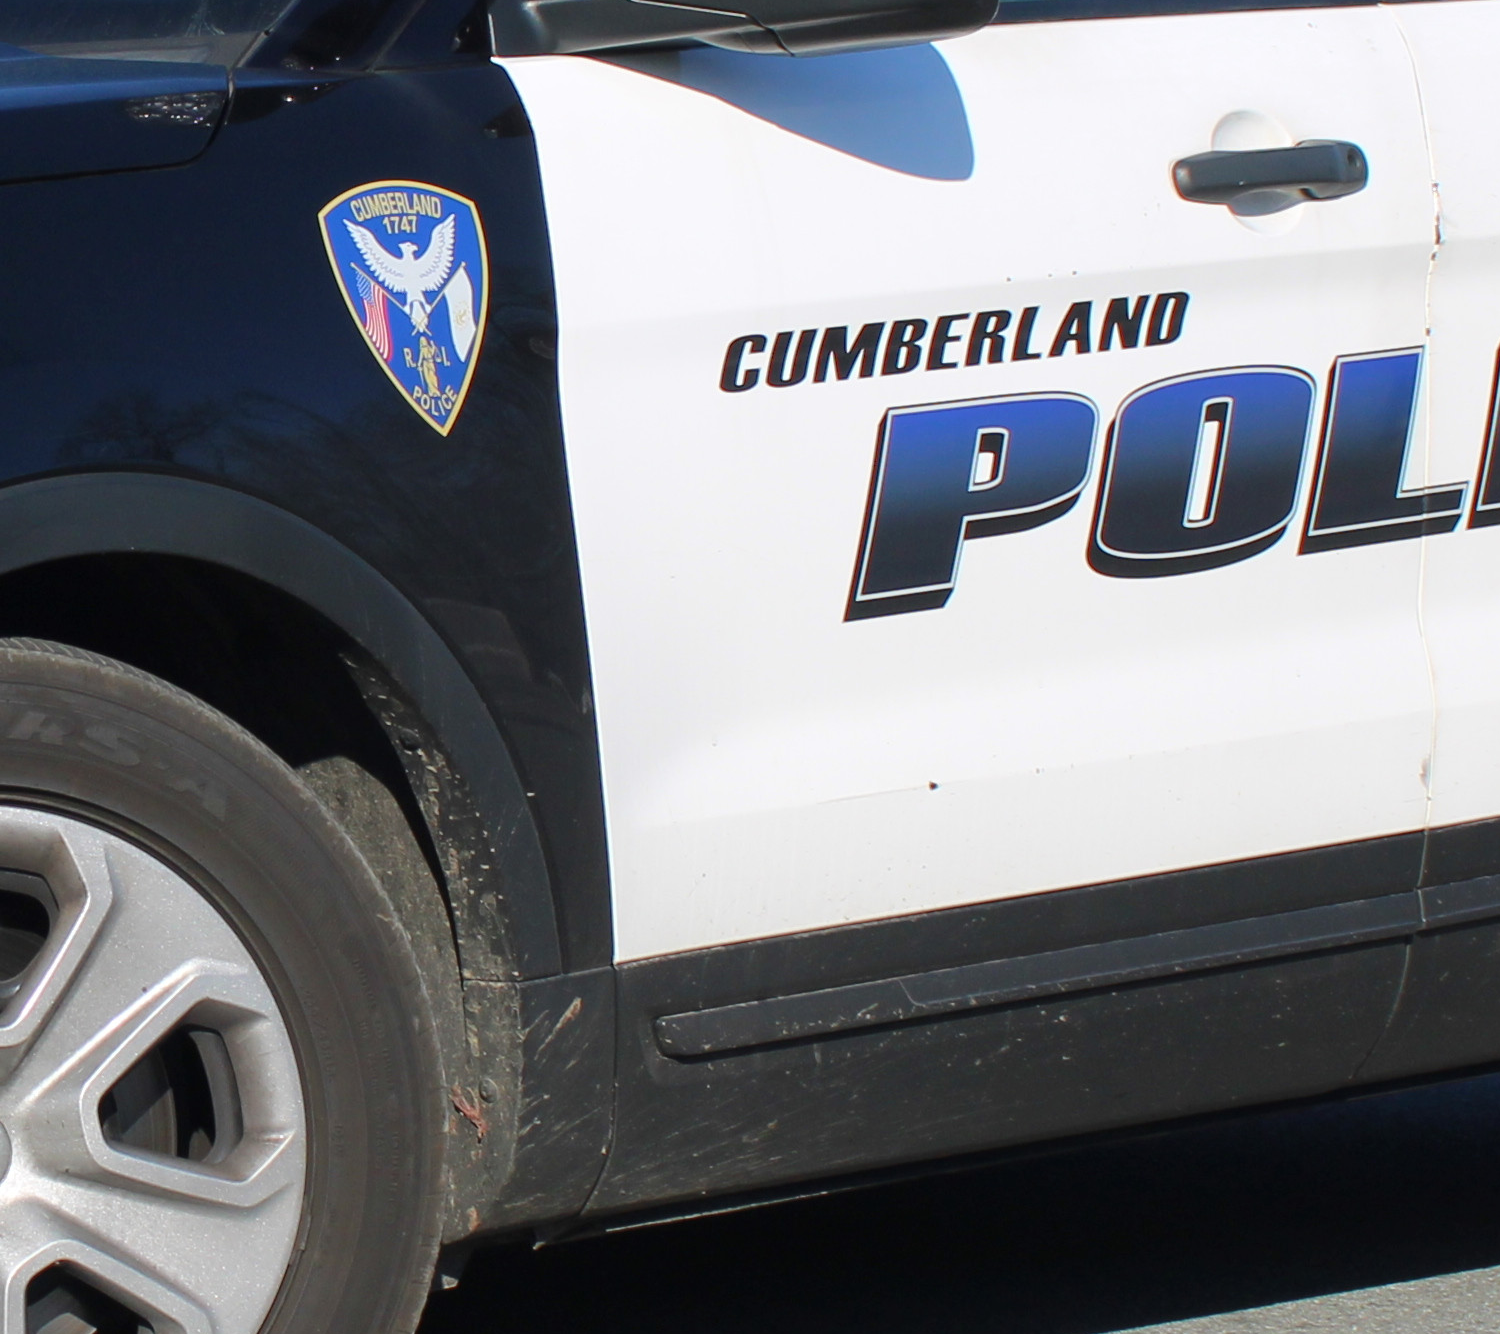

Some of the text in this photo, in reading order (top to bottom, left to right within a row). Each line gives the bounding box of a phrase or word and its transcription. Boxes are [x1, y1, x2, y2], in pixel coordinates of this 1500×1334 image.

[350, 192, 442, 222] CUMBERLAND
[382, 215, 417, 235] 1747
[718, 290, 1192, 394] CUMBERLAND
[412, 384, 458, 417] POLICE
